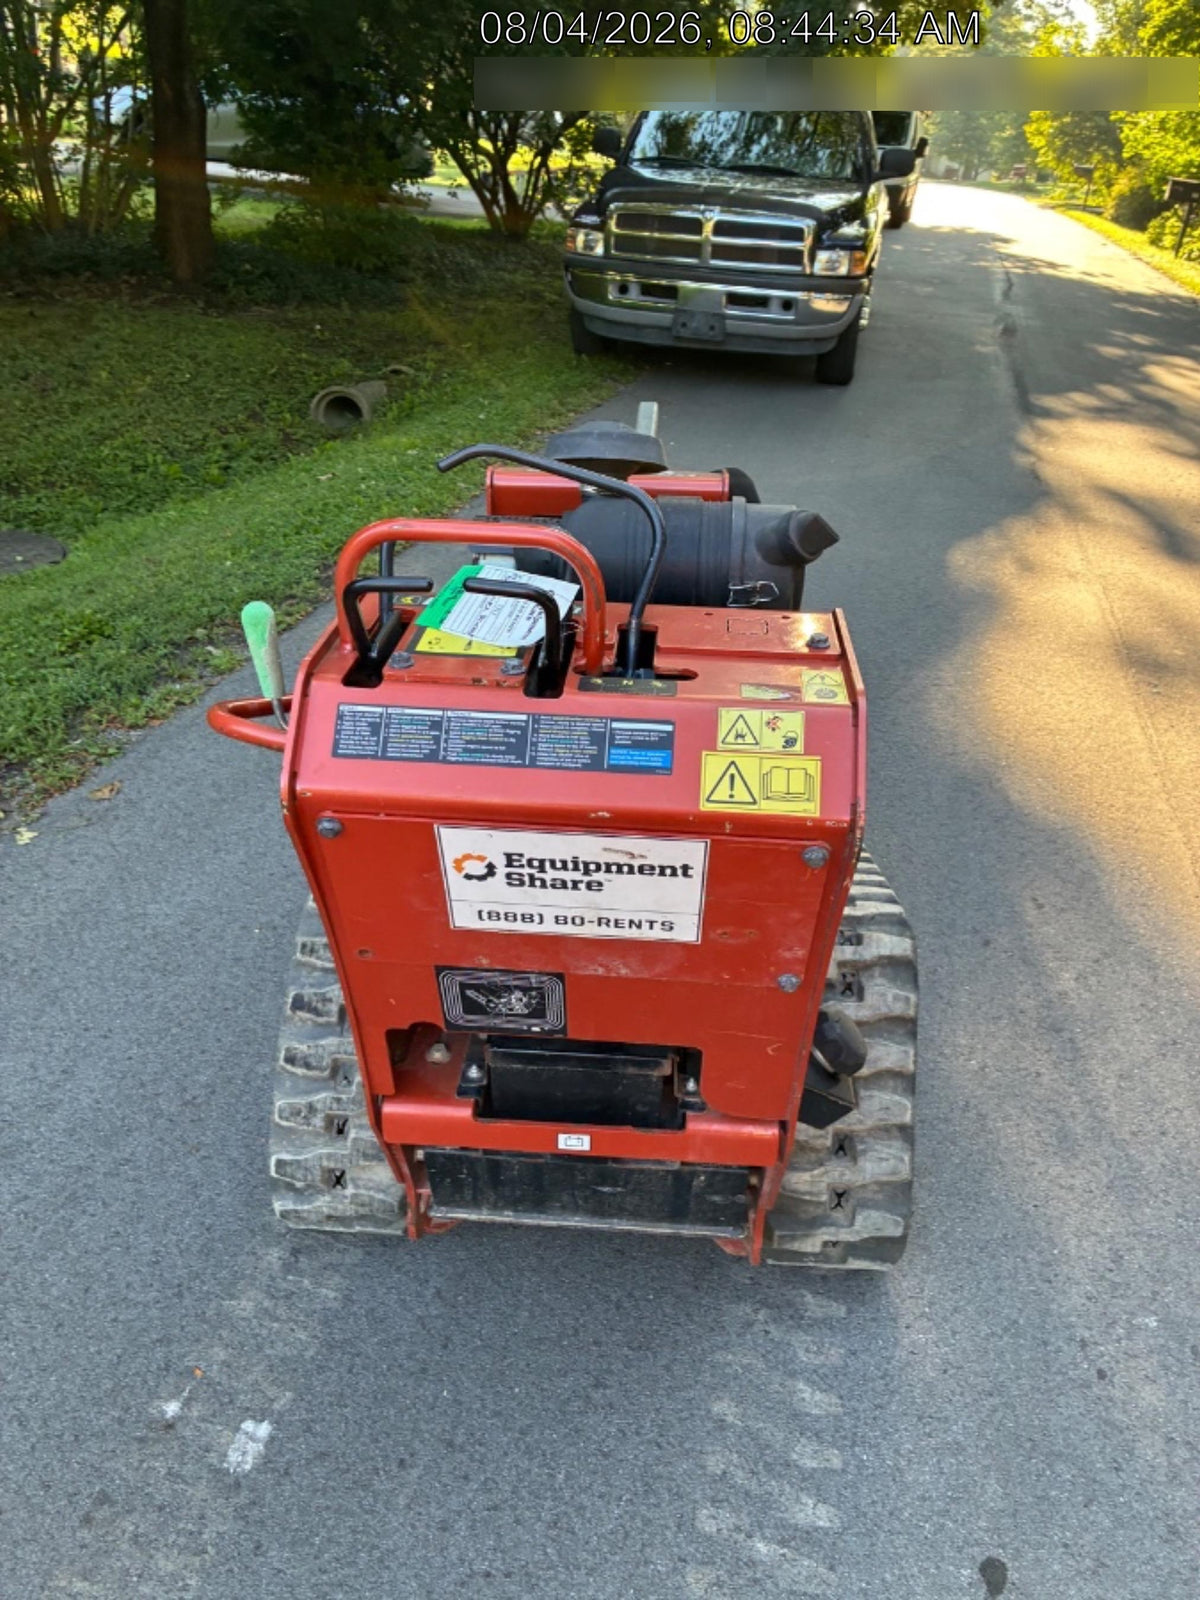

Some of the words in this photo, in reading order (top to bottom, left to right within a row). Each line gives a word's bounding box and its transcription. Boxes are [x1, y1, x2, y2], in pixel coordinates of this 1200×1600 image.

[503, 852, 694, 878] Equipment
[477, 908, 545, 926] (888)
[554, 914, 676, 932] 80-RENTS
